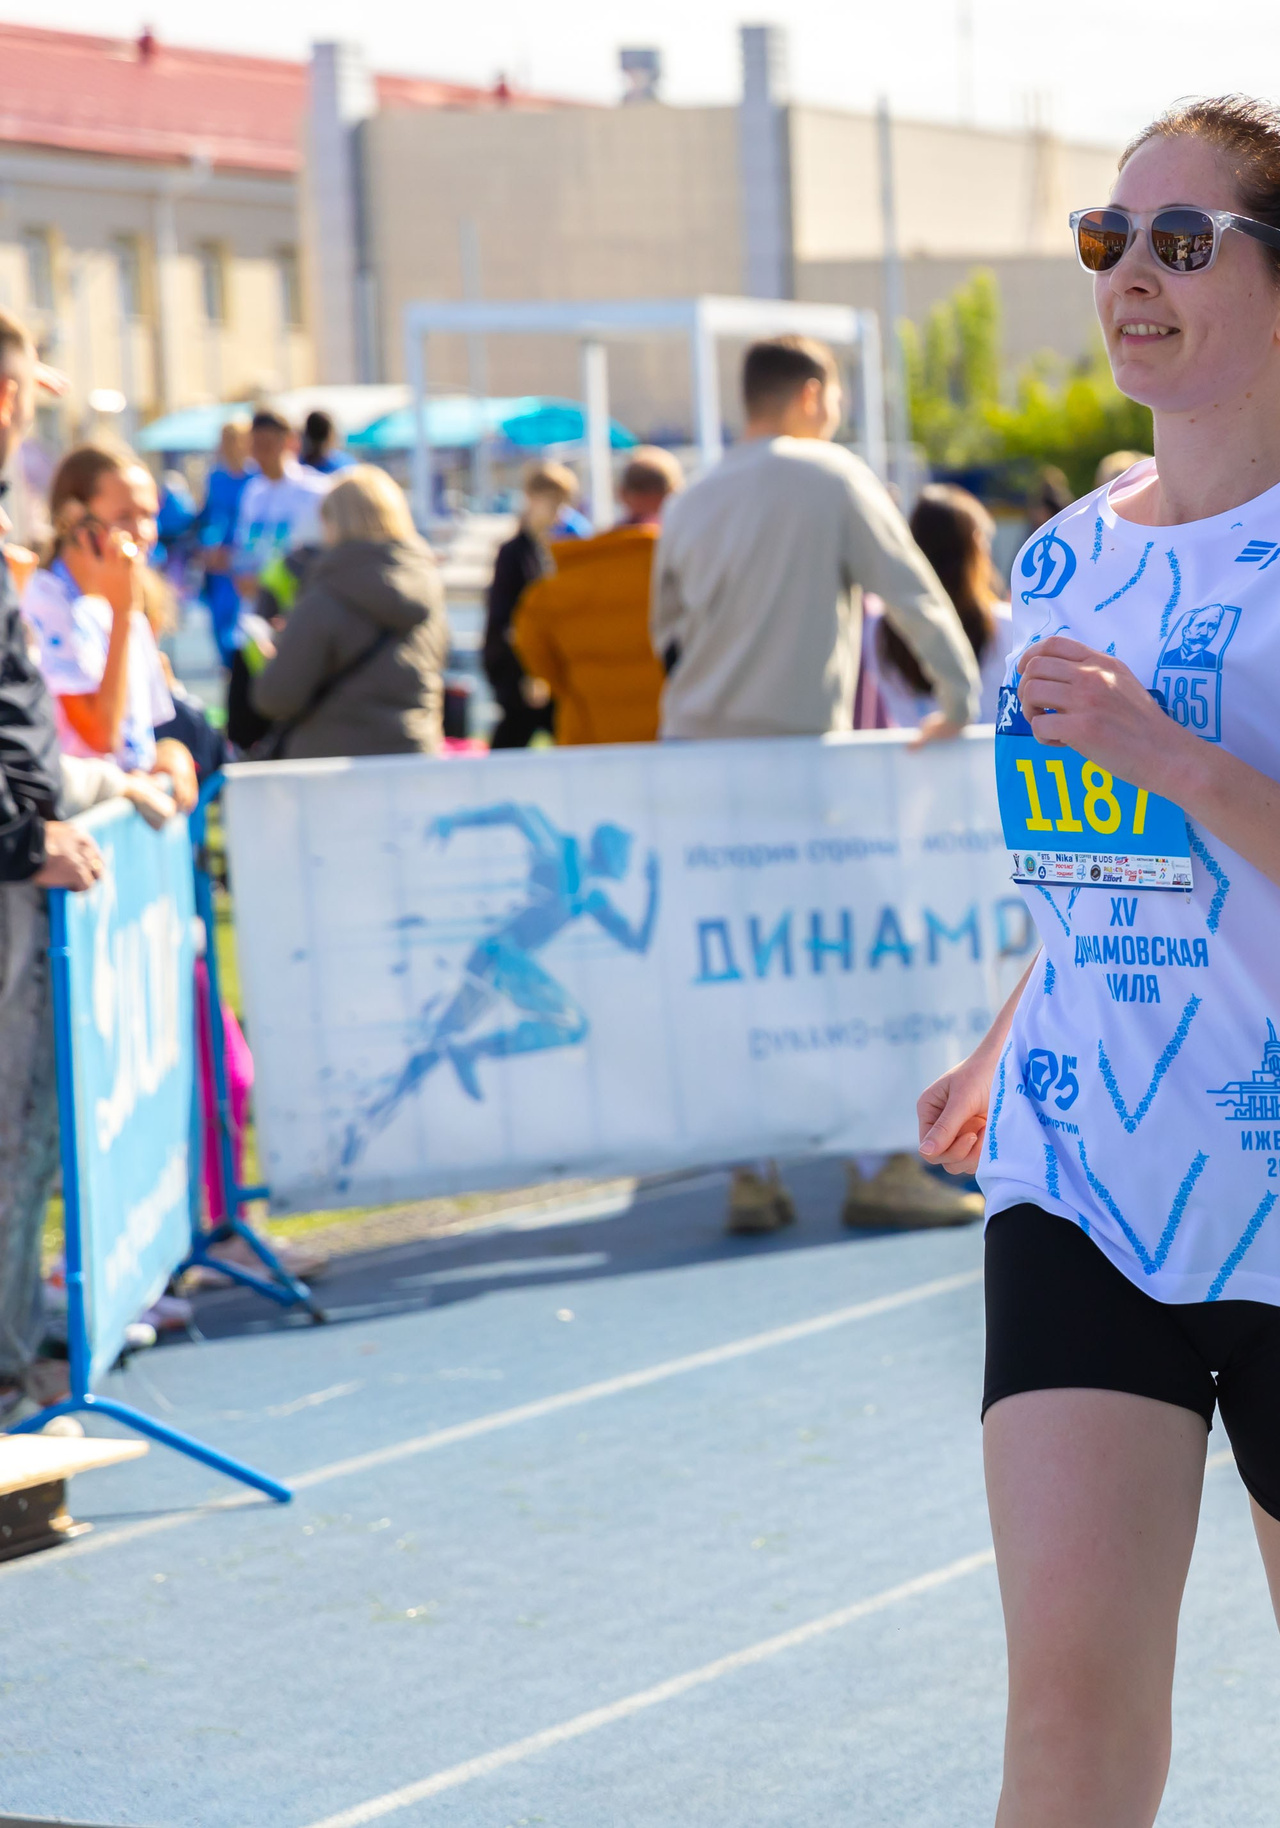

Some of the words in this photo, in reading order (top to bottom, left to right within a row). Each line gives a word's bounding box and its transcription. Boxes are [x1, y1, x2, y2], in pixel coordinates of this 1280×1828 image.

[1162, 676, 1209, 729] 185
[1055, 853, 1073, 863] Nika
[1098, 855, 1113, 863] UDS
[1102, 874, 1122, 882] Effort
[1109, 897, 1138, 927] XV
